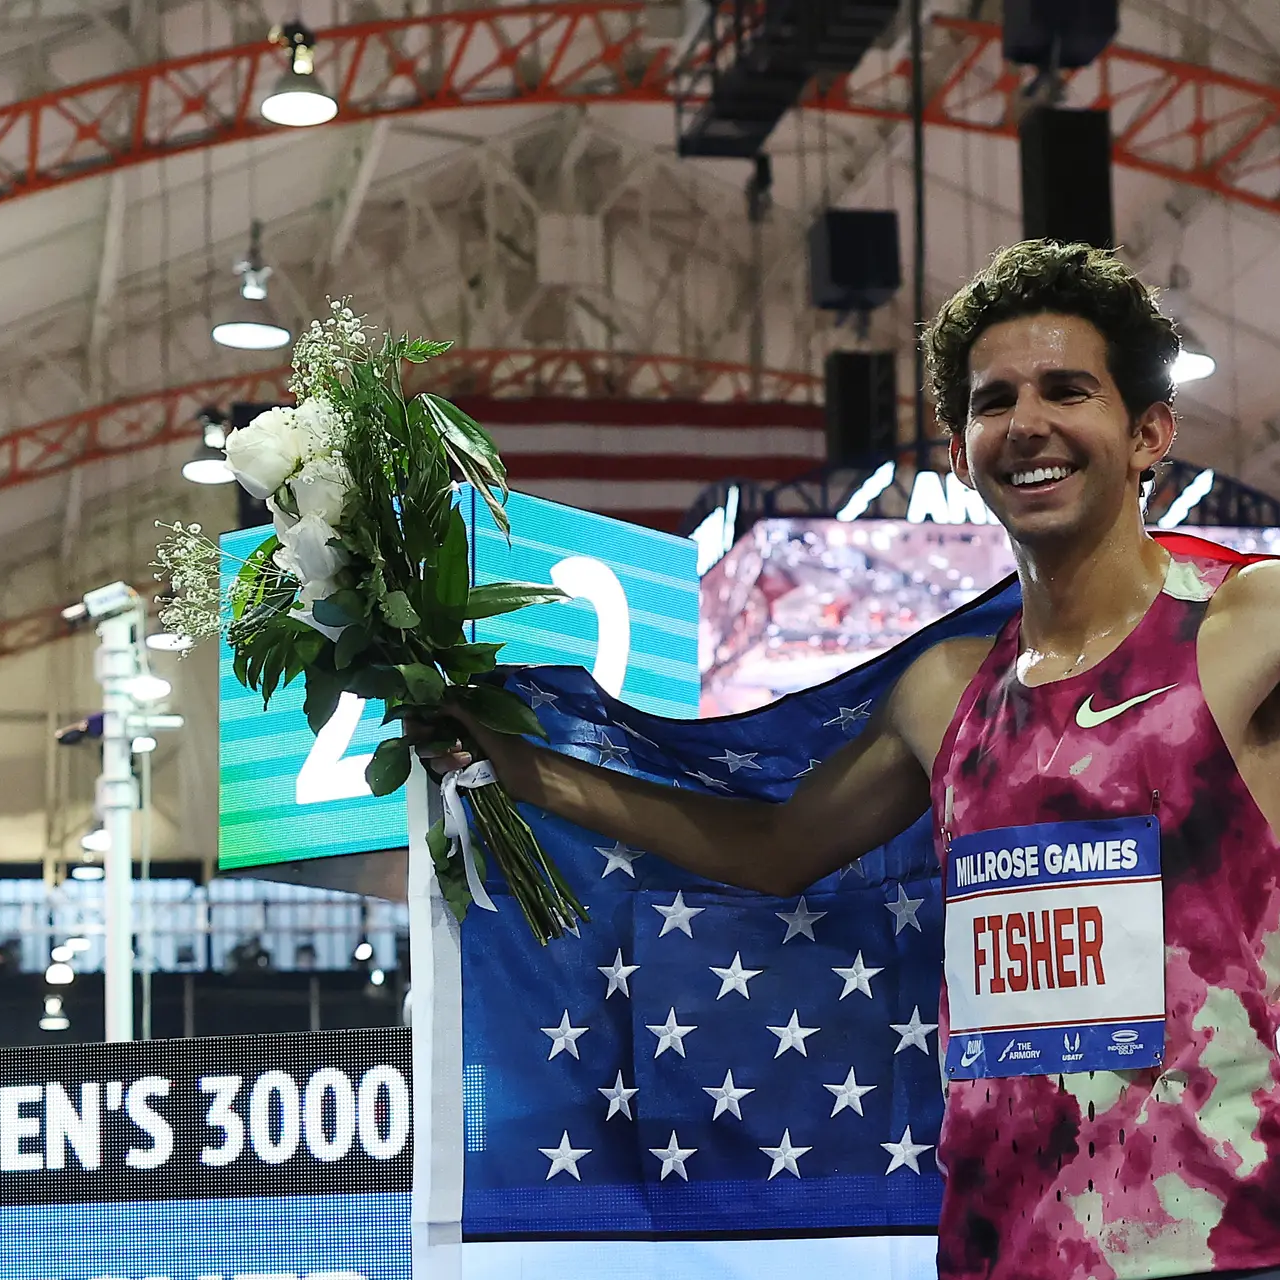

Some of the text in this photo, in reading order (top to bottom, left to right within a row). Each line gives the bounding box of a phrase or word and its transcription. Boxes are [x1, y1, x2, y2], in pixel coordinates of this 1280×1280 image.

[956, 839, 1138, 888] MILLROSE GAMES
[973, 906, 1106, 995] FISHER
[1009, 1050, 1040, 1060] ARMORY
[1017, 1042, 1032, 1050] THE
